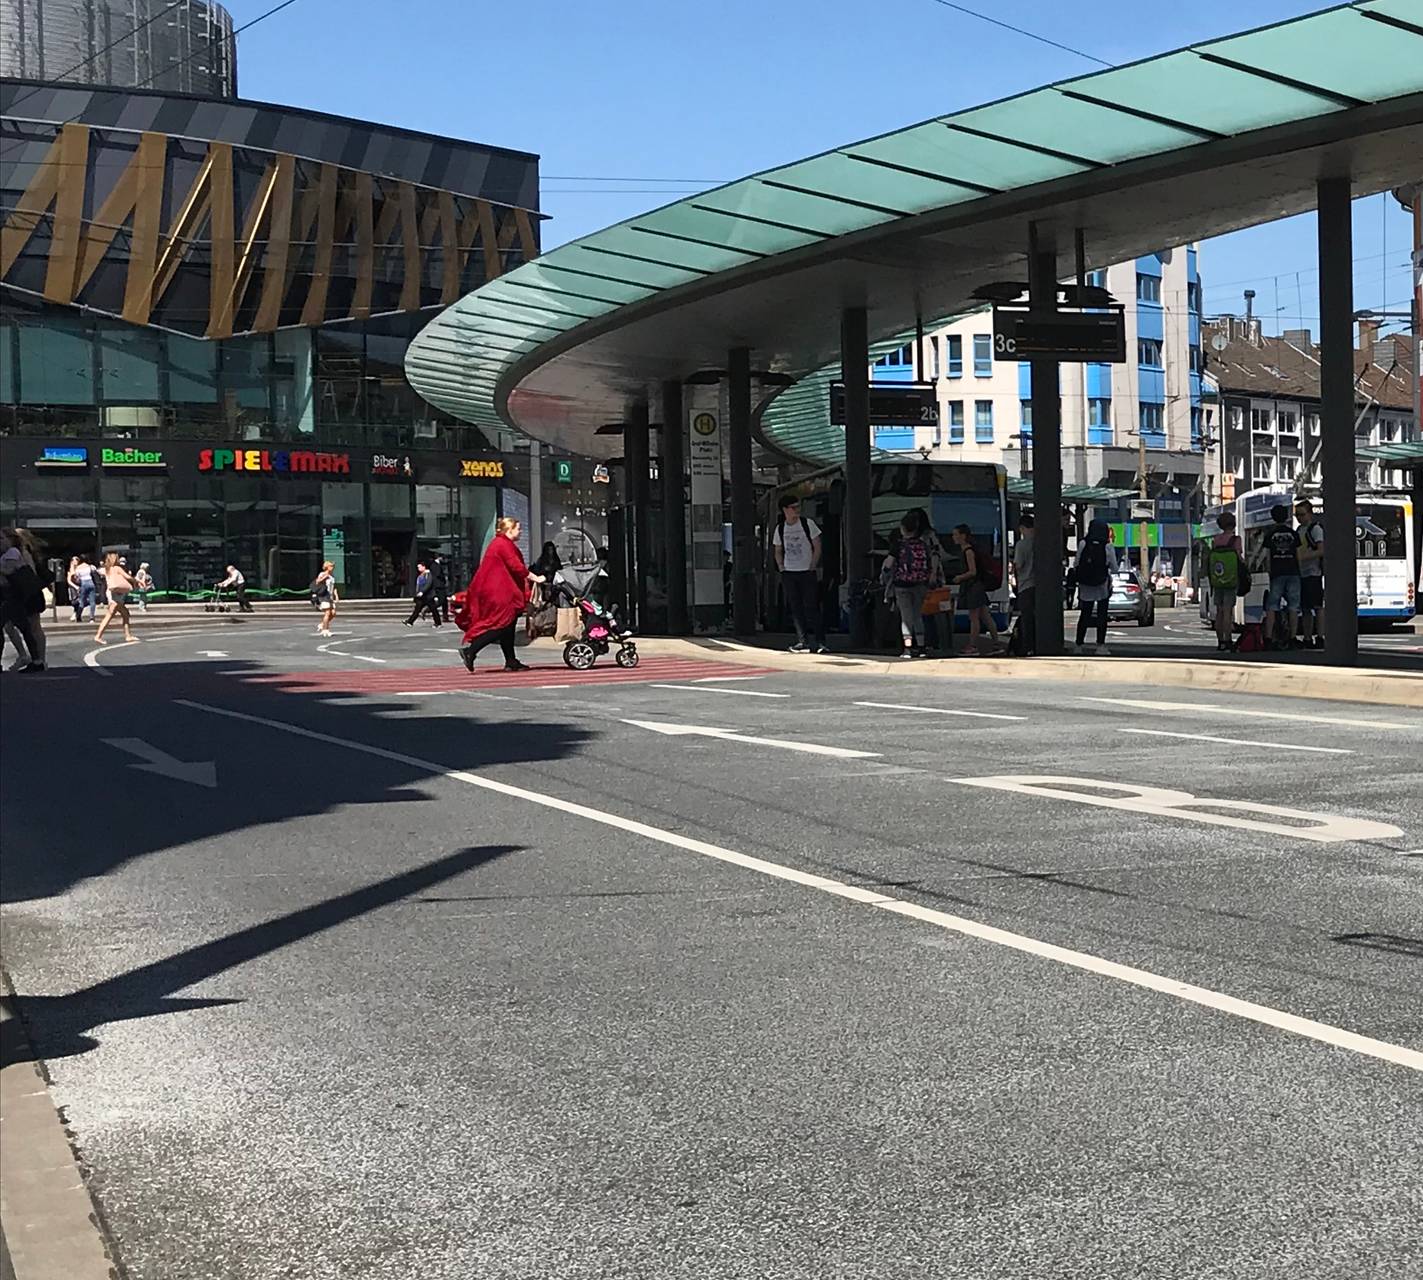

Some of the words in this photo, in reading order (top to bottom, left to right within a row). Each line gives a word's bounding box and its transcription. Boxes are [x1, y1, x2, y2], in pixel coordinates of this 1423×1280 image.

[996, 333, 1017, 353] 3c
[920, 405, 938, 421] 2b
[102, 447, 162, 463] Bacher
[373, 455, 399, 468] Biber
